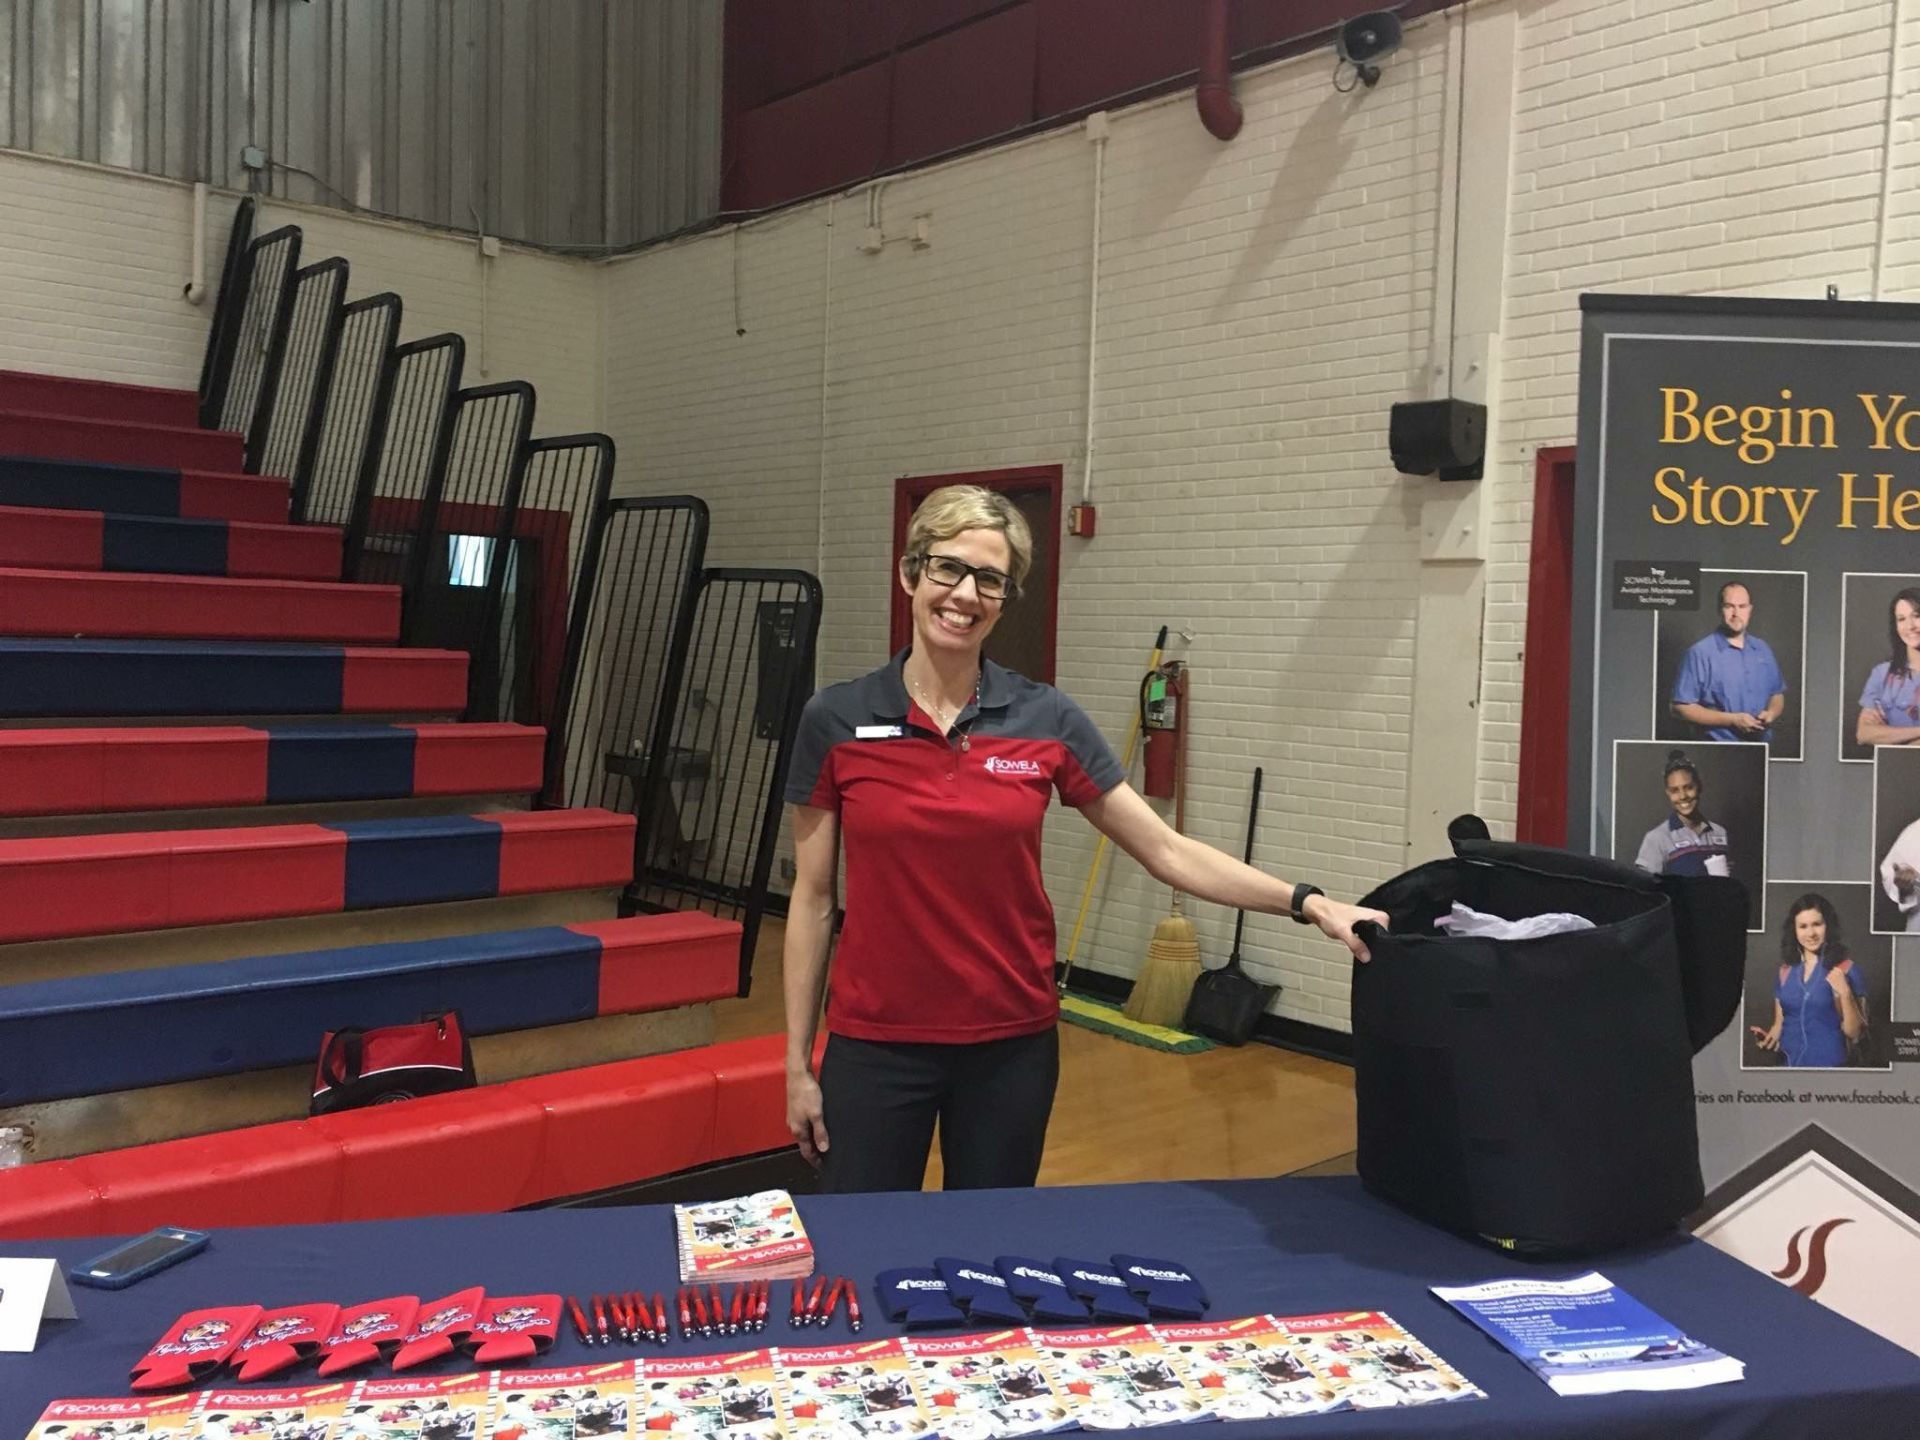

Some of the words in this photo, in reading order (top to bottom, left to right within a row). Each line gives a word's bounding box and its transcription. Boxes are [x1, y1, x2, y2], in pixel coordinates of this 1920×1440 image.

[1658, 387, 1838, 465] Begin
[1857, 394, 1920, 451] Yo
[1651, 467, 1819, 546] Story
[1837, 473, 1920, 530] He
[995, 759, 1039, 770] SOWELA
[1718, 1094, 1733, 1104] on
[1736, 1089, 1795, 1104] Facebook
[1799, 1090, 1812, 1104] at
[1168, 1325, 1231, 1337] SOWELA
[1045, 1332, 1108, 1344] SOWELA
[921, 1339, 984, 1351] SOWELA
[789, 1349, 855, 1361] SOWELA
[658, 1359, 723, 1372] SOWELA
[515, 1371, 584, 1384] SOWELA
[367, 1381, 437, 1393] SOWELA
[226, 1392, 298, 1403] SOWELA
[65, 1402, 142, 1413] SOWELA
